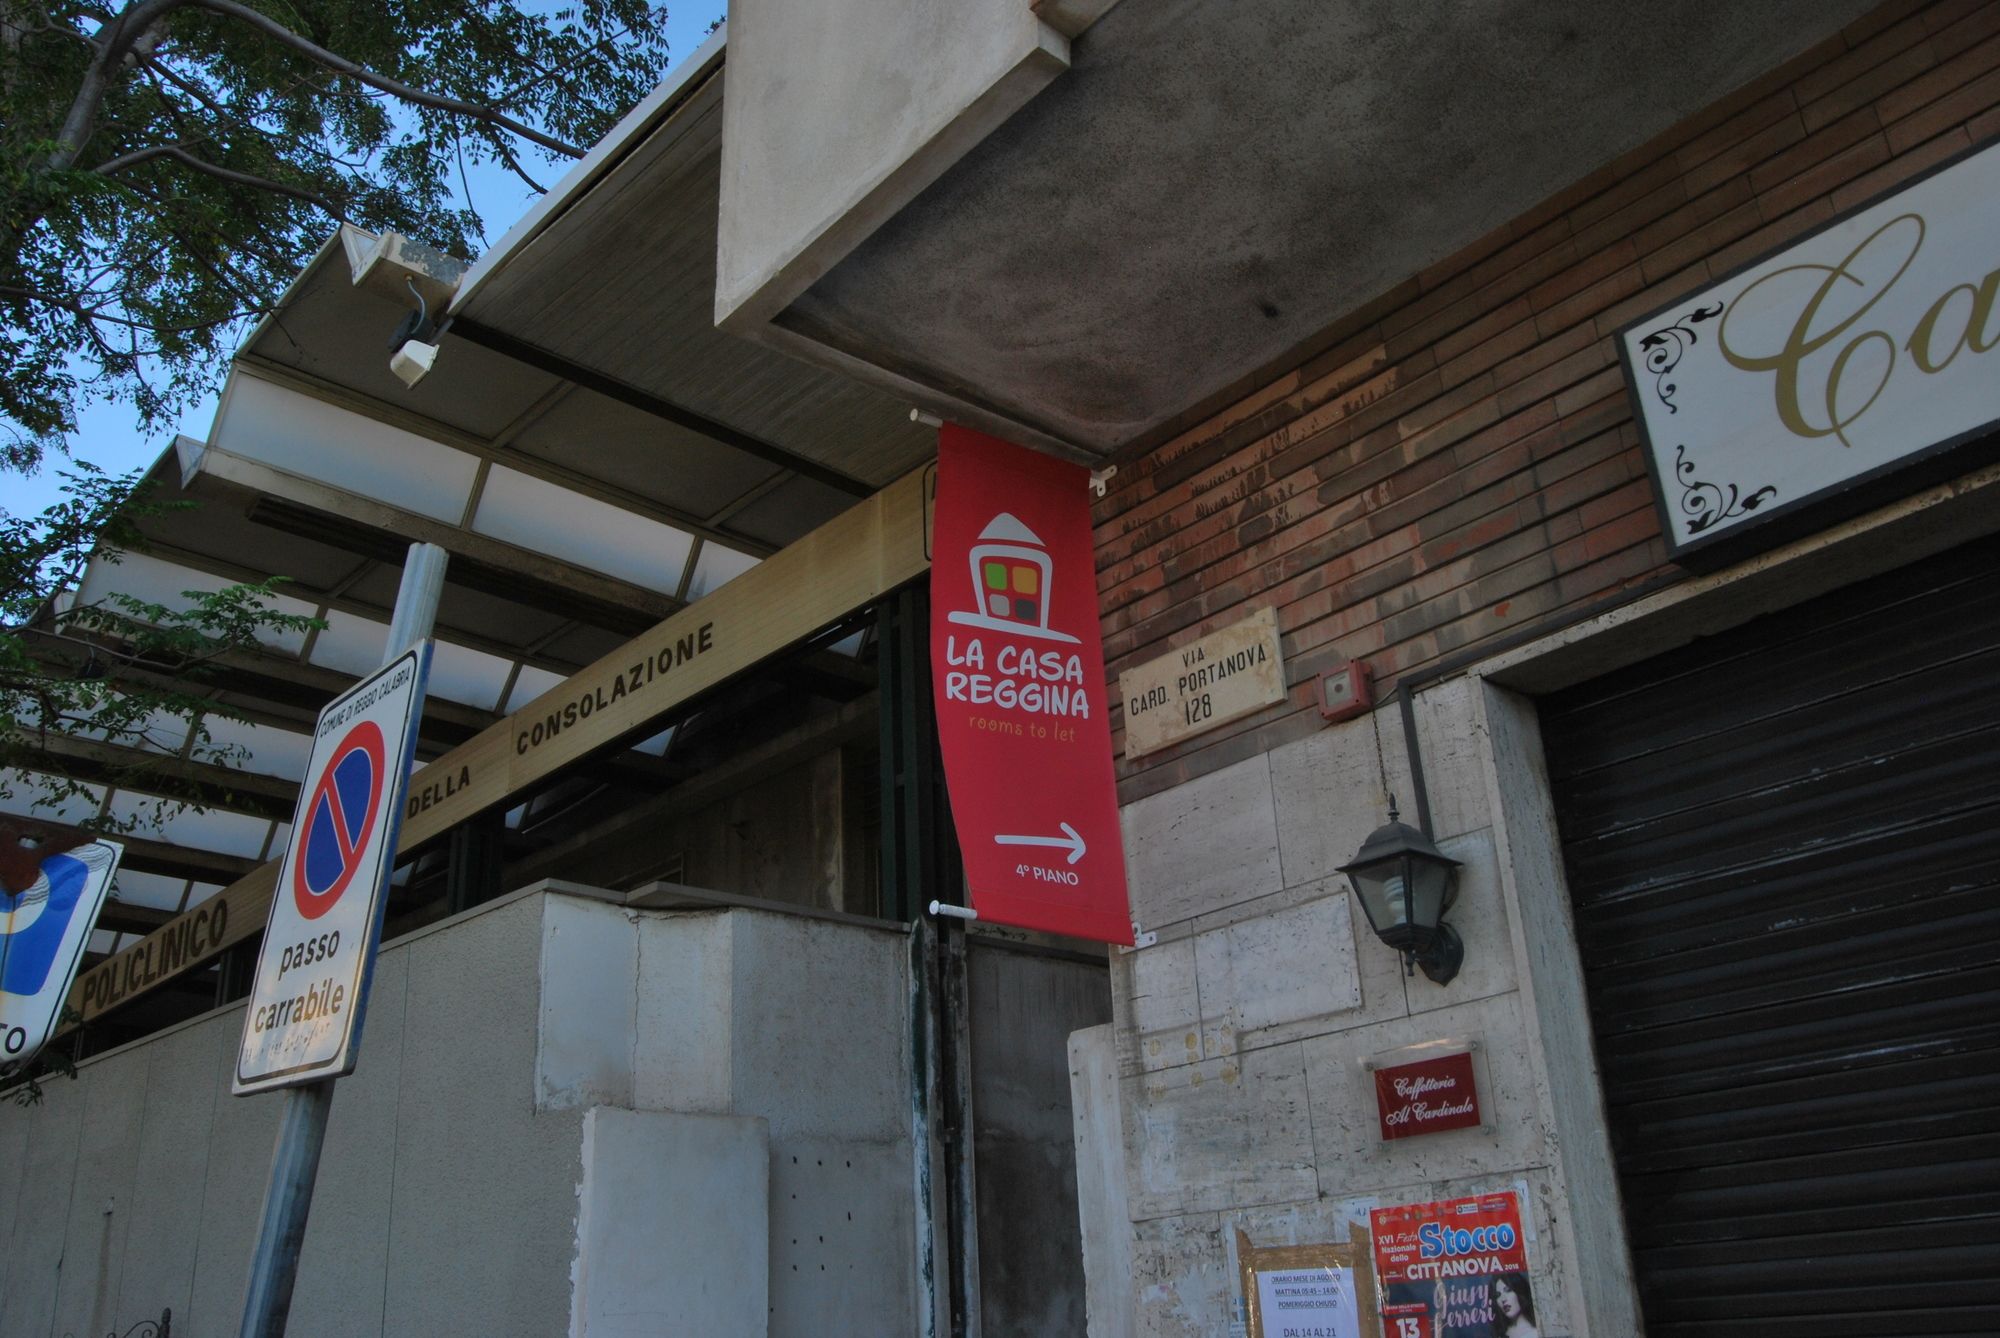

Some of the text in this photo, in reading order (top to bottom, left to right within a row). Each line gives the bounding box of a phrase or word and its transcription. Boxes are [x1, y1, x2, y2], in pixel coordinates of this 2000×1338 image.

[945, 635, 1083, 685] LA CASA
[1182, 647, 1205, 667] VIA
[1130, 643, 1266, 716] CARD. PORTANOVA
[320, 666, 410, 739] COMUNE DI REGGIO CALABRIA
[945, 671, 1089, 720] REGGINA
[1185, 693, 1212, 725] 128
[969, 714, 1075, 743] rooms to let
[82, 621, 713, 1020] POLICLINICO DELLA CONSOLAZIONE
[1034, 867, 1079, 886] PIANO
[278, 930, 340, 981] passo
[255, 978, 344, 1033] carrabile
[1394, 1075, 1457, 1101] Caffetteria
[1385, 1096, 1474, 1126] Al Cardinale
[1378, 1234, 1394, 1245] XVI
[1418, 1222, 1516, 1259] Stocco
[1391, 1254, 1409, 1263] dello
[1407, 1256, 1503, 1280] CITTANOVA
[1275, 1287, 1301, 1295] MATTINA
[1283, 1327, 1336, 1338] DAL 14 AL 21
